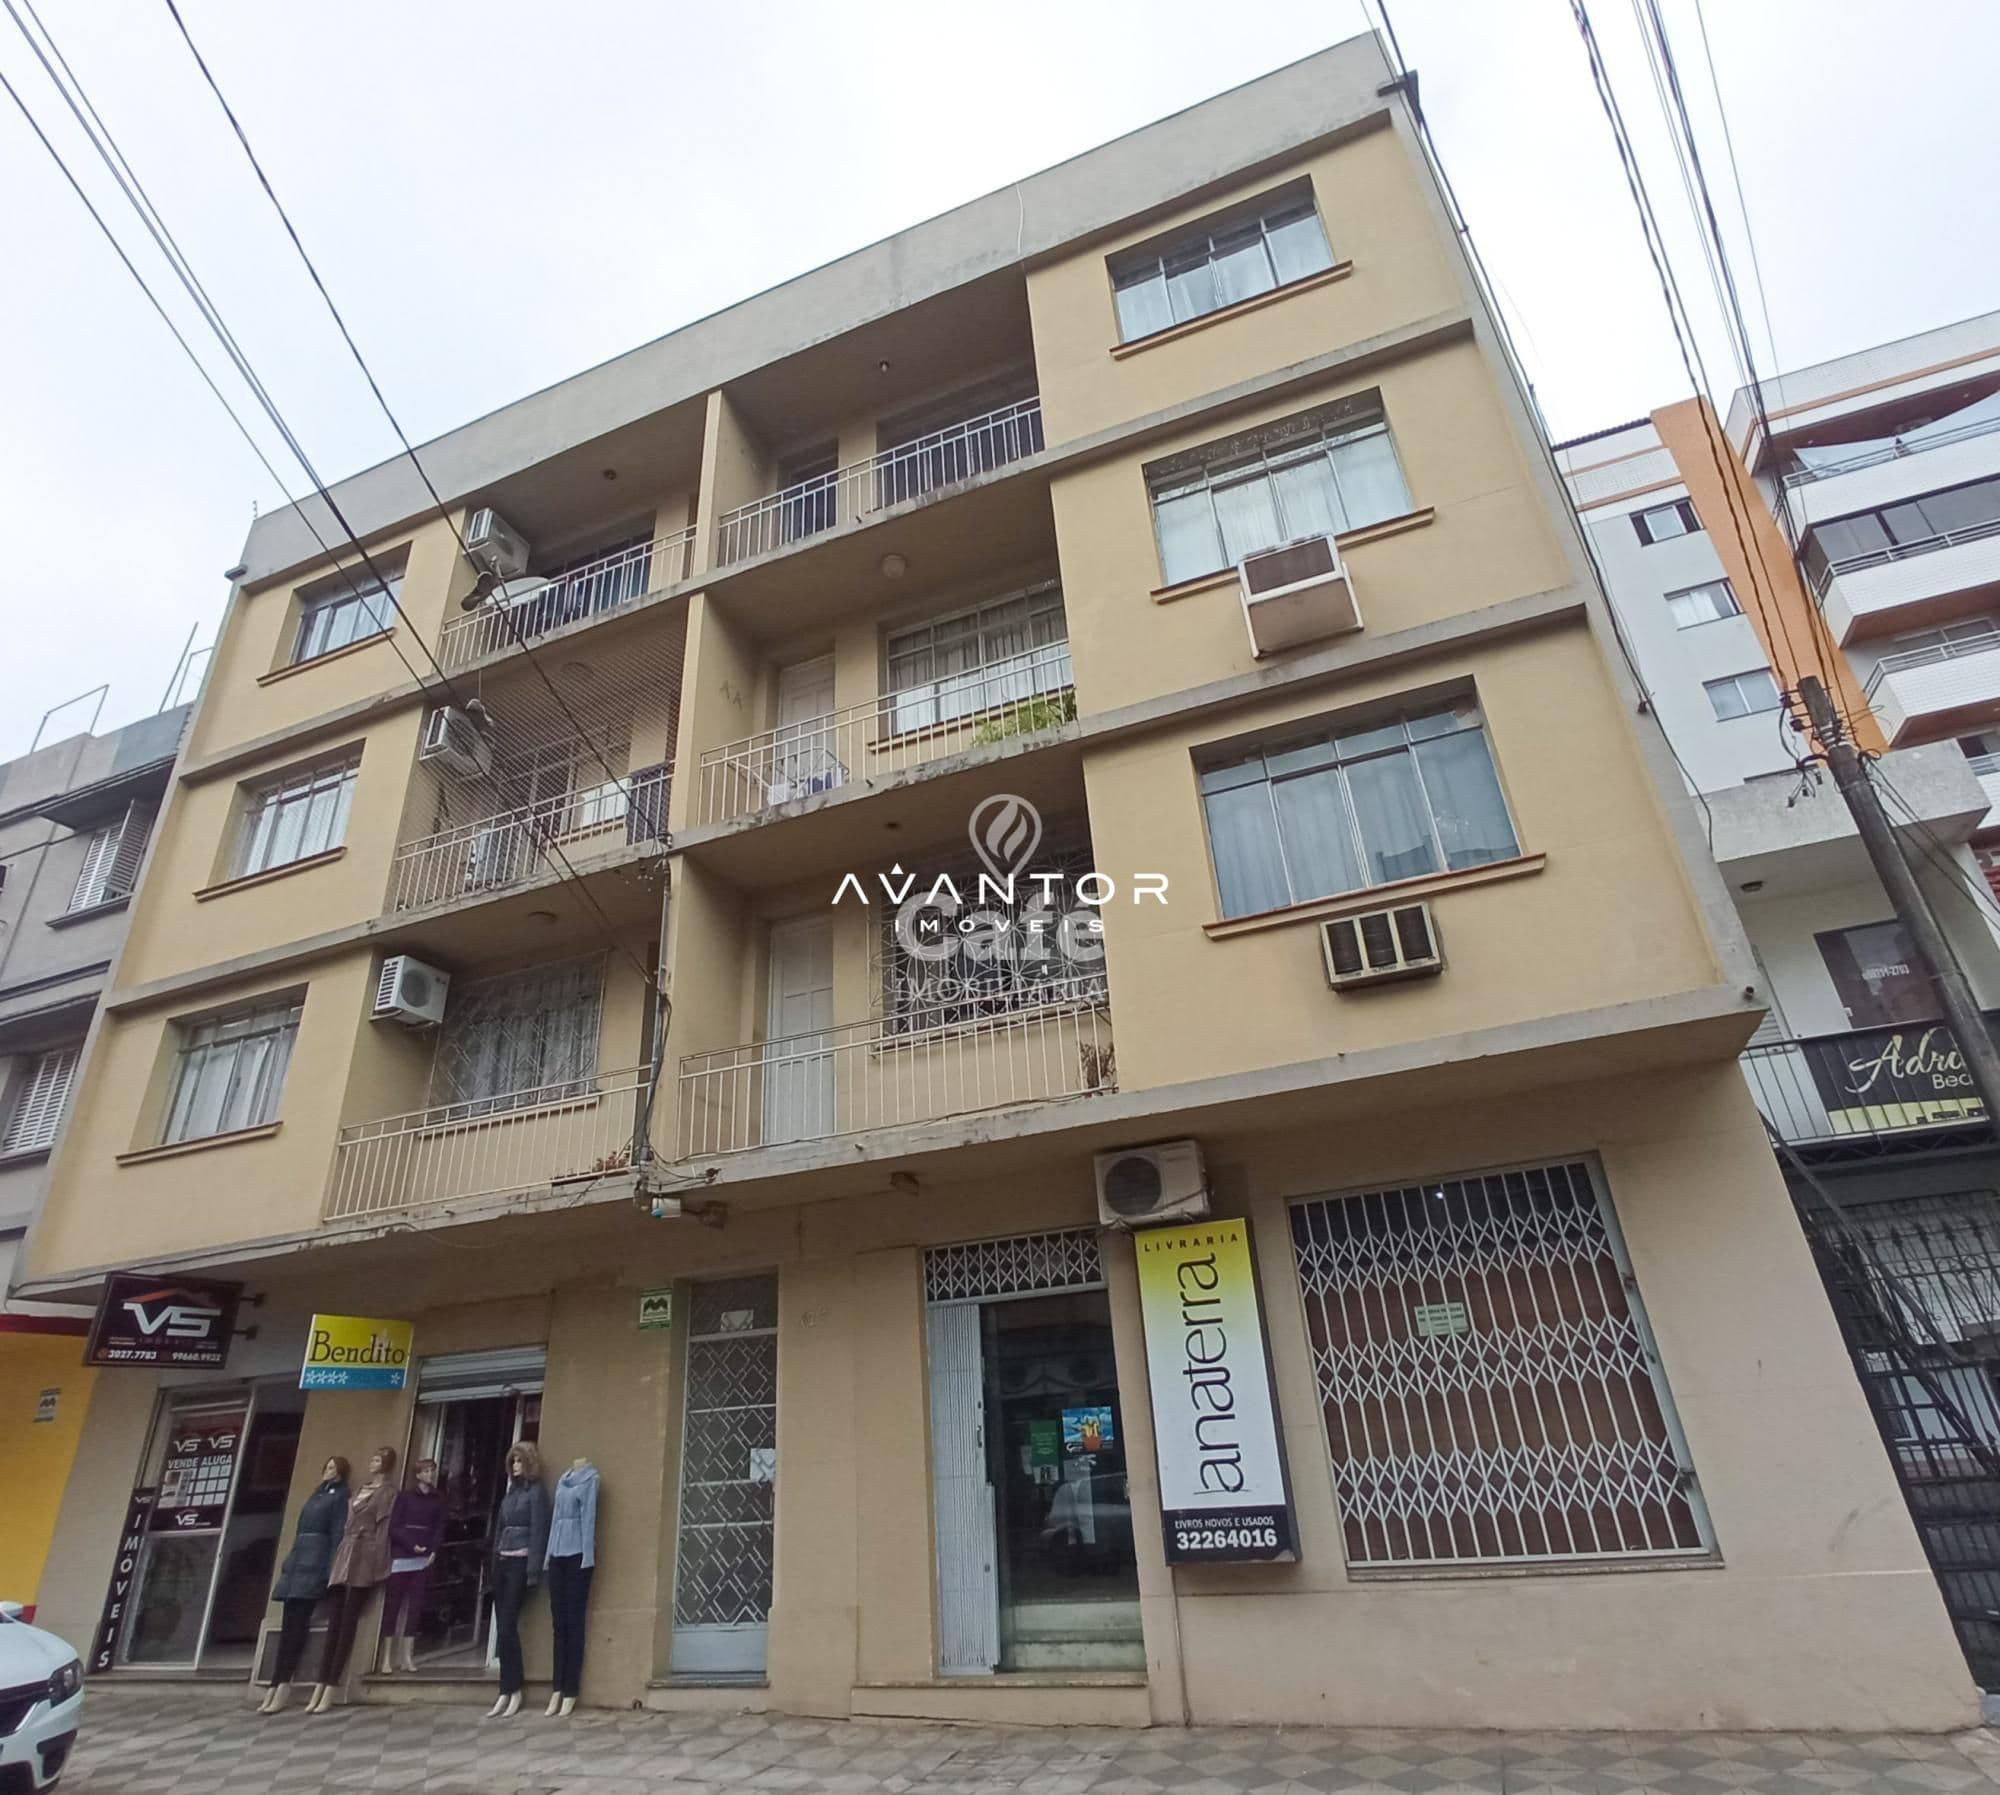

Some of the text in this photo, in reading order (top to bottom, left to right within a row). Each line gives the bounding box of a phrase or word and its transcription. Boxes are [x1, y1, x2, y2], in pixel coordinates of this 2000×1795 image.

[1144, 1233, 1238, 1252] LIVRARIA
[123, 1302, 222, 1337] VS
[308, 1330, 405, 1364] Bendito
[1177, 1252, 1245, 1493] anaterra
[168, 1455, 232, 1469] VENDE ALUGA
[1175, 1515, 1275, 1529] LIVROS NOVOS E USADOS
[1177, 1528, 1277, 1549] 32264016
[98, 1513, 144, 1668] IMÓVEIS
